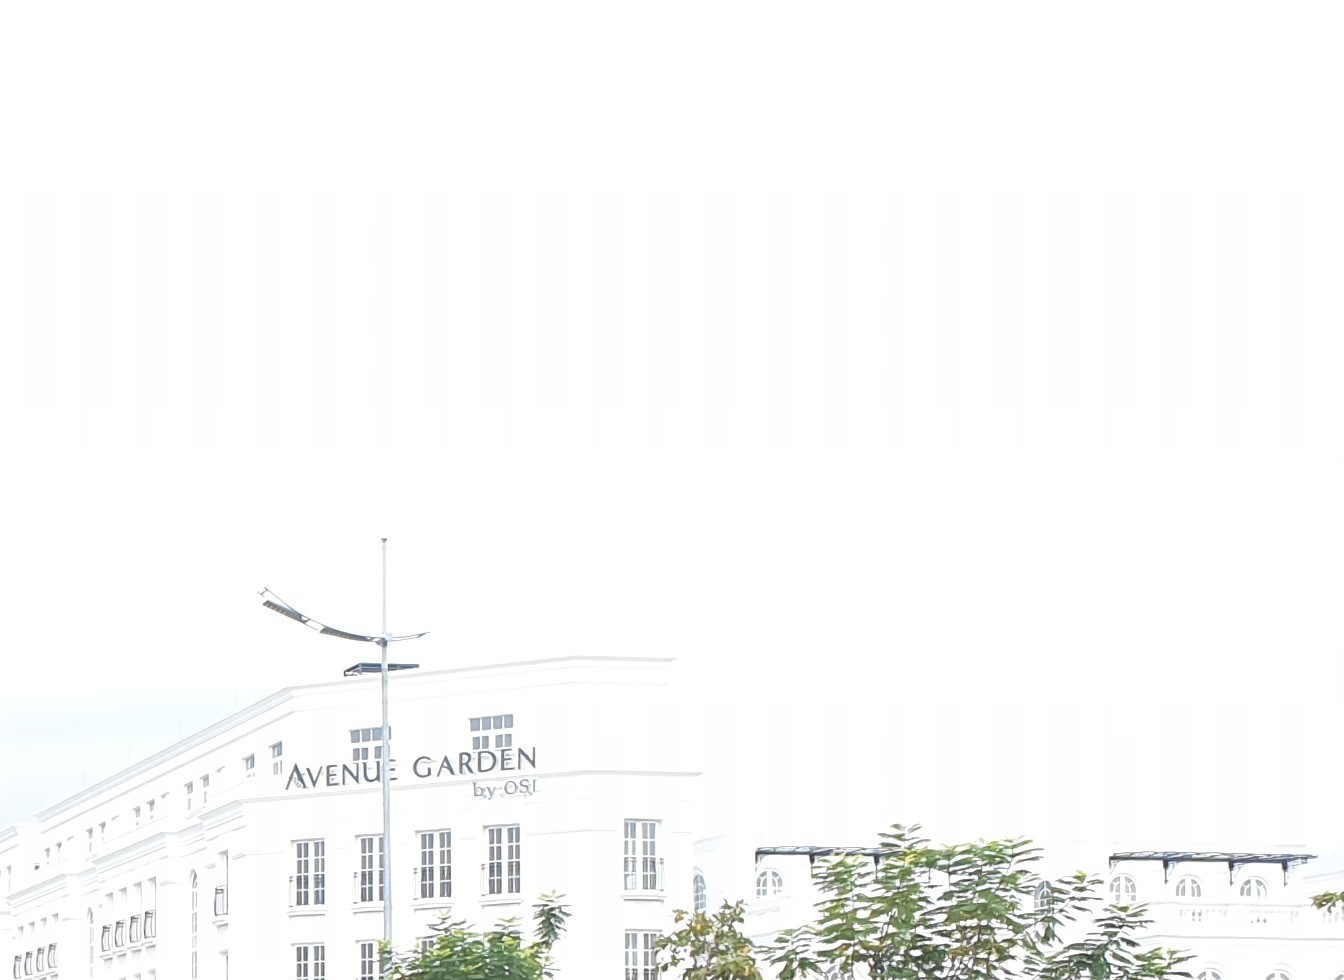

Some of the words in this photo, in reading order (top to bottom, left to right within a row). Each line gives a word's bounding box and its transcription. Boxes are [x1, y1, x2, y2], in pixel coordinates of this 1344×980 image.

[285, 759, 398, 790] AVENUE
[412, 746, 536, 779] GARDEN
[472, 781, 496, 800] by
[503, 778, 539, 796] OSI
